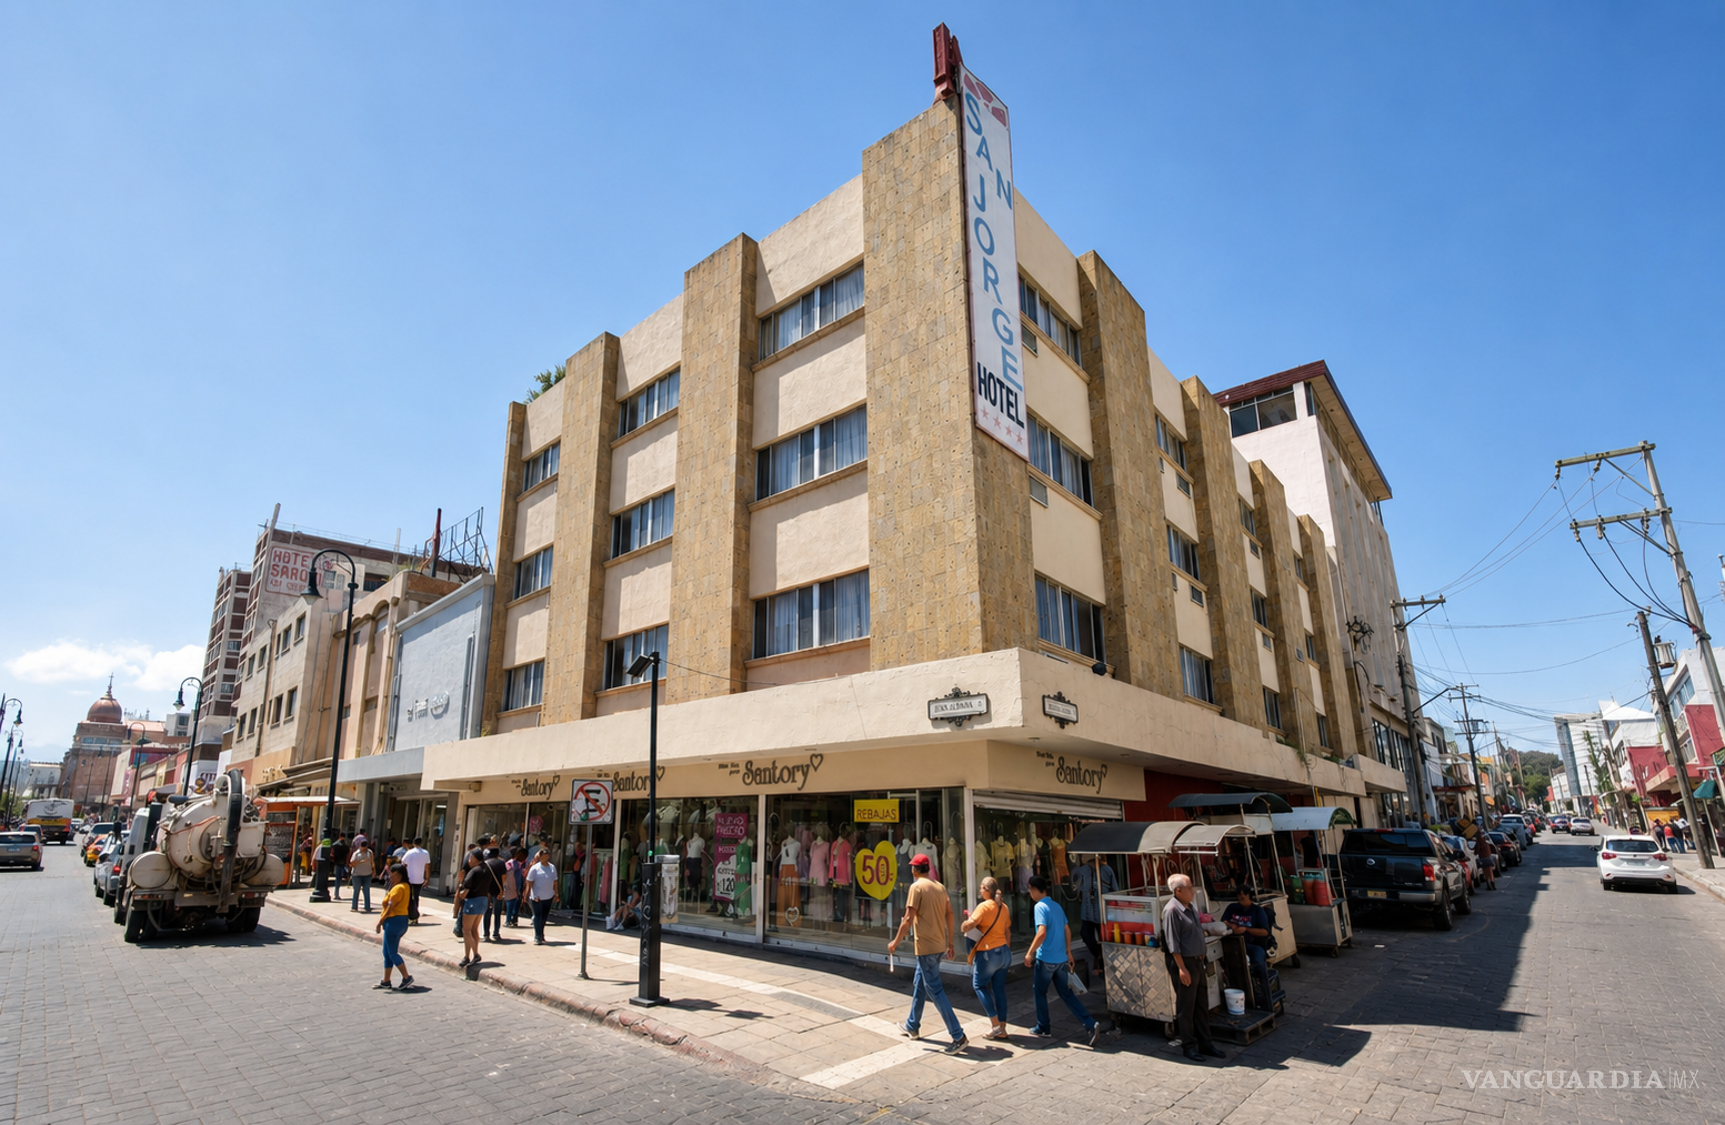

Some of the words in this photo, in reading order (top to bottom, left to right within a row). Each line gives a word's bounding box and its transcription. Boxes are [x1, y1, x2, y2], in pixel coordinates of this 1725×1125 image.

[965, 92, 1013, 210] SAN
[973, 174, 1023, 392] JORGE
[977, 361, 1025, 429] HOTEL
[272, 550, 312, 569] HOTE
[520, 778, 554, 800] Santory
[742, 760, 811, 791] Santory
[1056, 756, 1103, 795] Santory
[857, 808, 897, 820] REBAJAS
